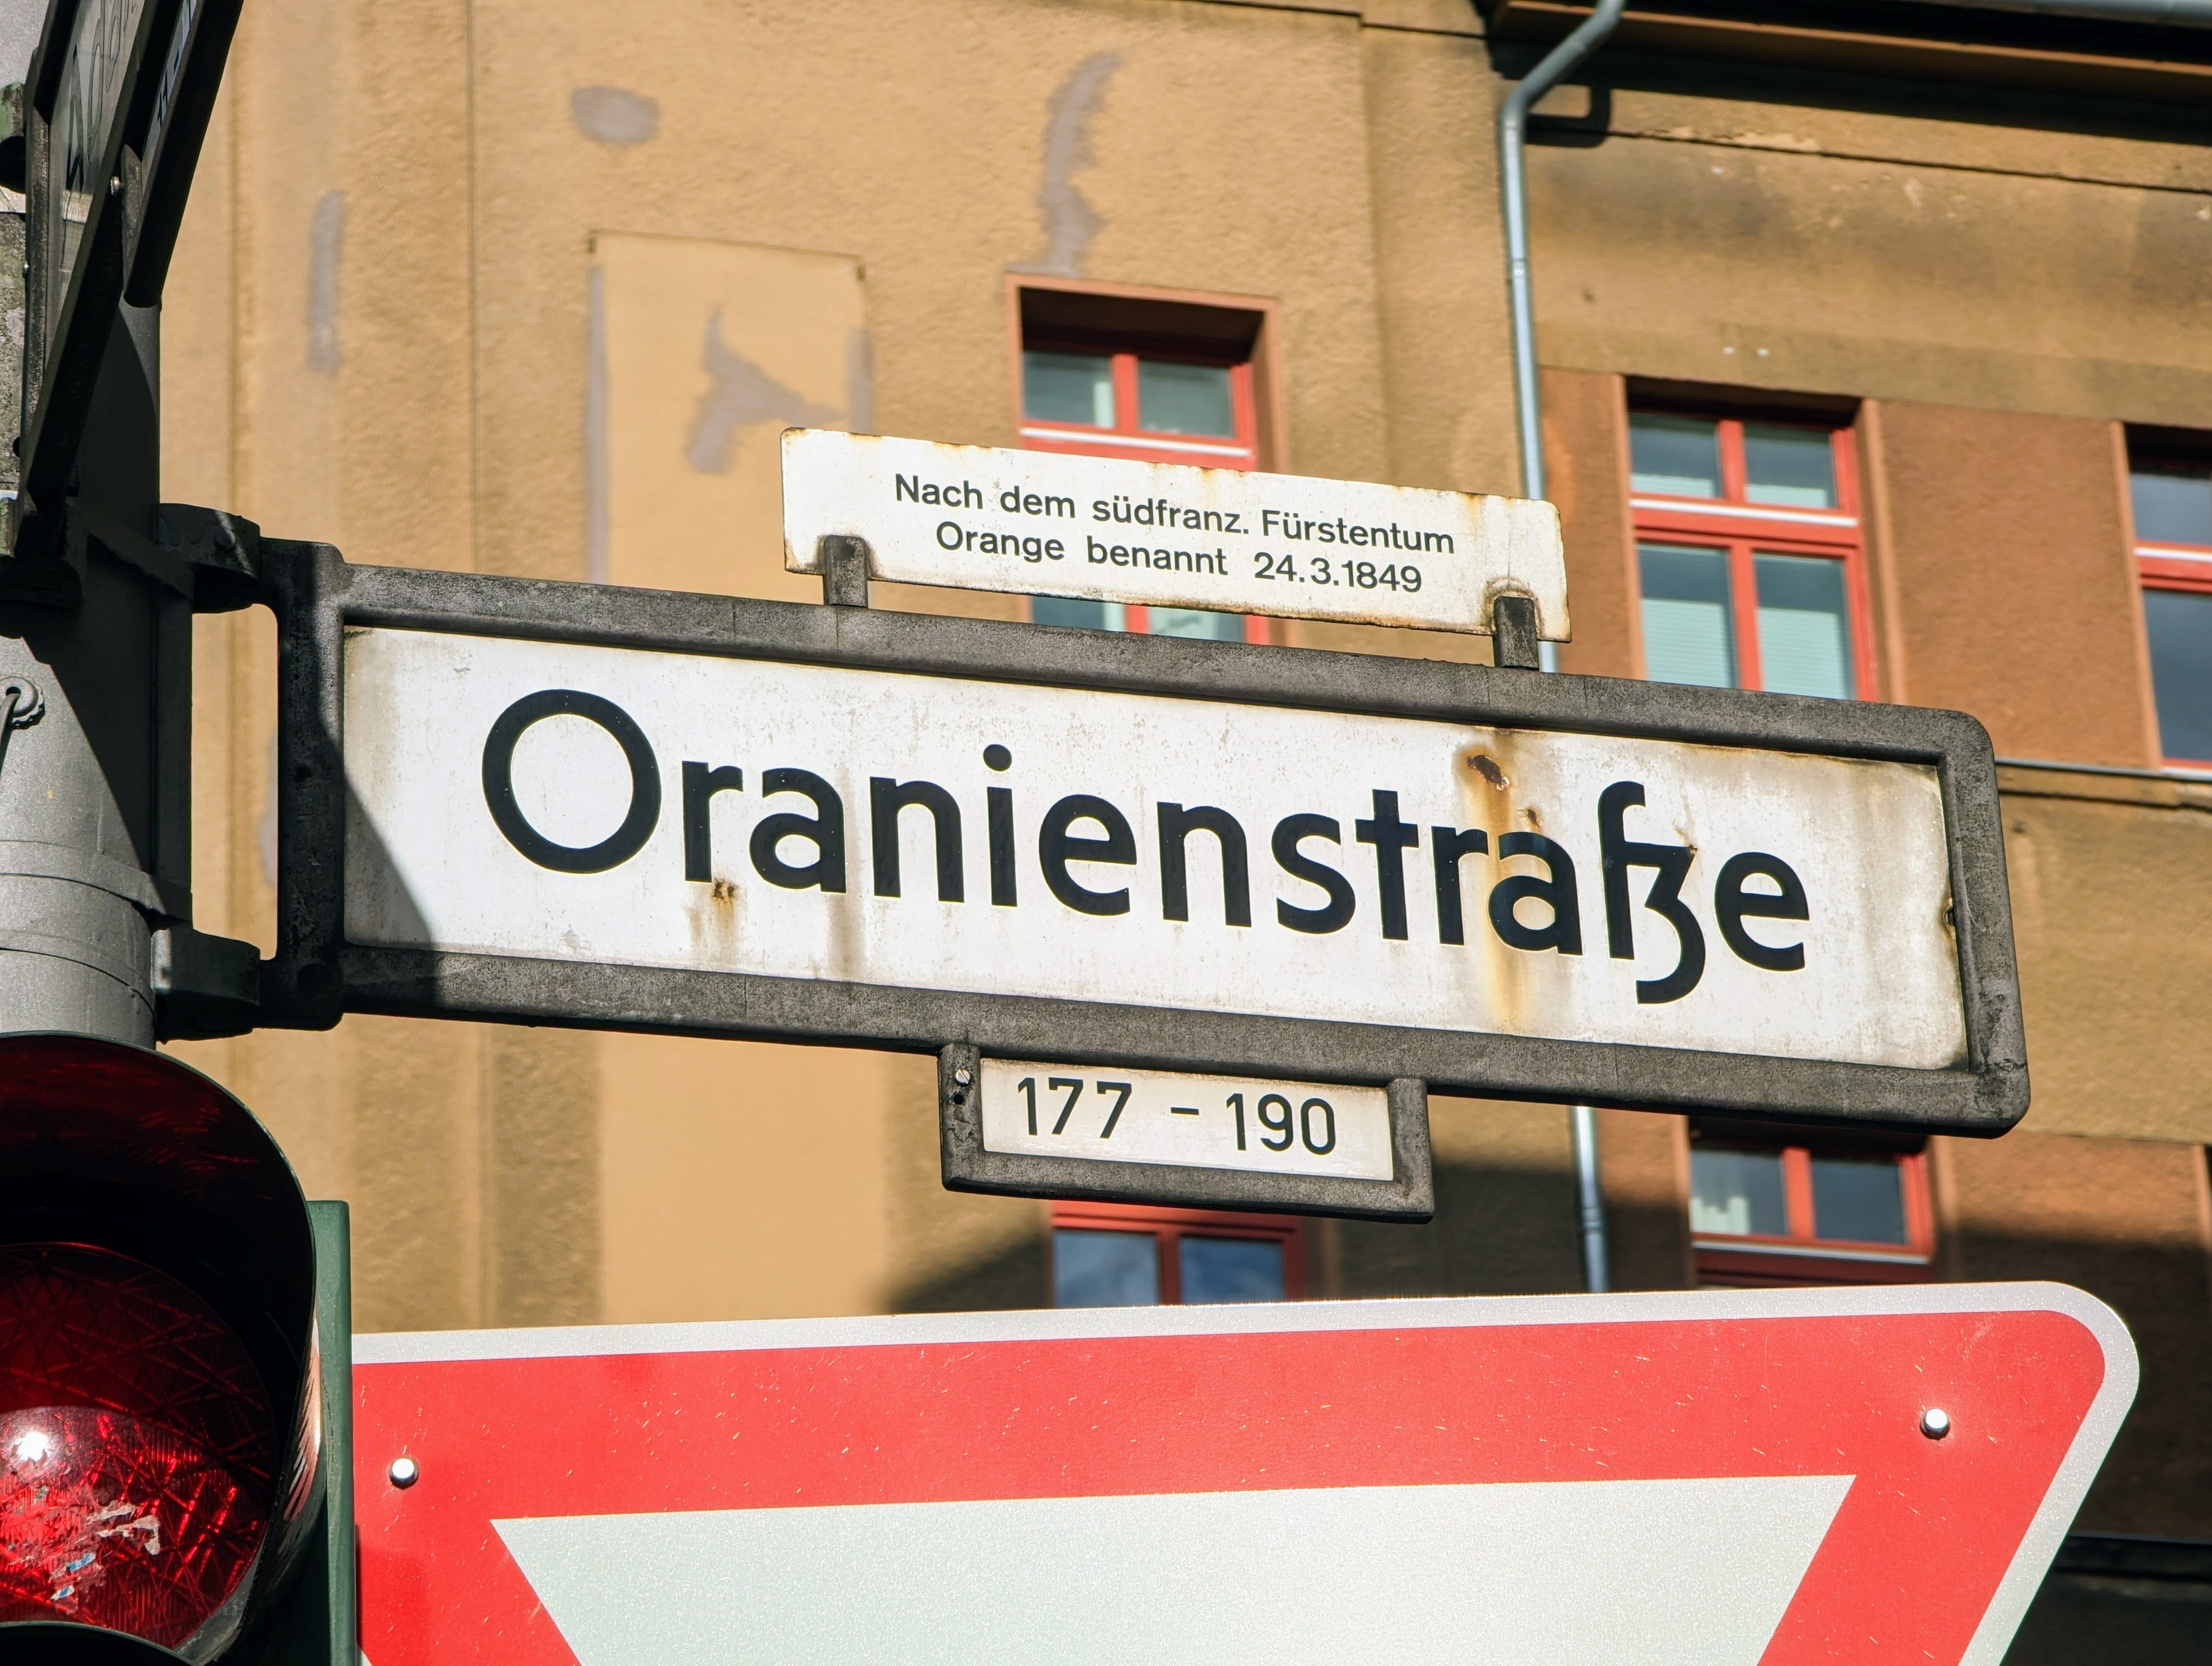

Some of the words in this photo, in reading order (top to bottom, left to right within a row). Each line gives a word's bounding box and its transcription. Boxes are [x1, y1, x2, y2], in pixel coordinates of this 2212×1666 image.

[895, 473, 983, 509] Nach
[1000, 485, 1075, 518] dem
[1092, 495, 1250, 536] südfranz.
[1262, 509, 1454, 554] Fürstentum
[936, 521, 1064, 563] Orange
[1086, 535, 1228, 575] benannt
[1254, 552, 1422, 593] 24.3.1849
[481, 689, 1811, 1004] Oranienstraße
[1017, 1077, 1133, 1139] 177
[1226, 1092, 1336, 1156] 190
